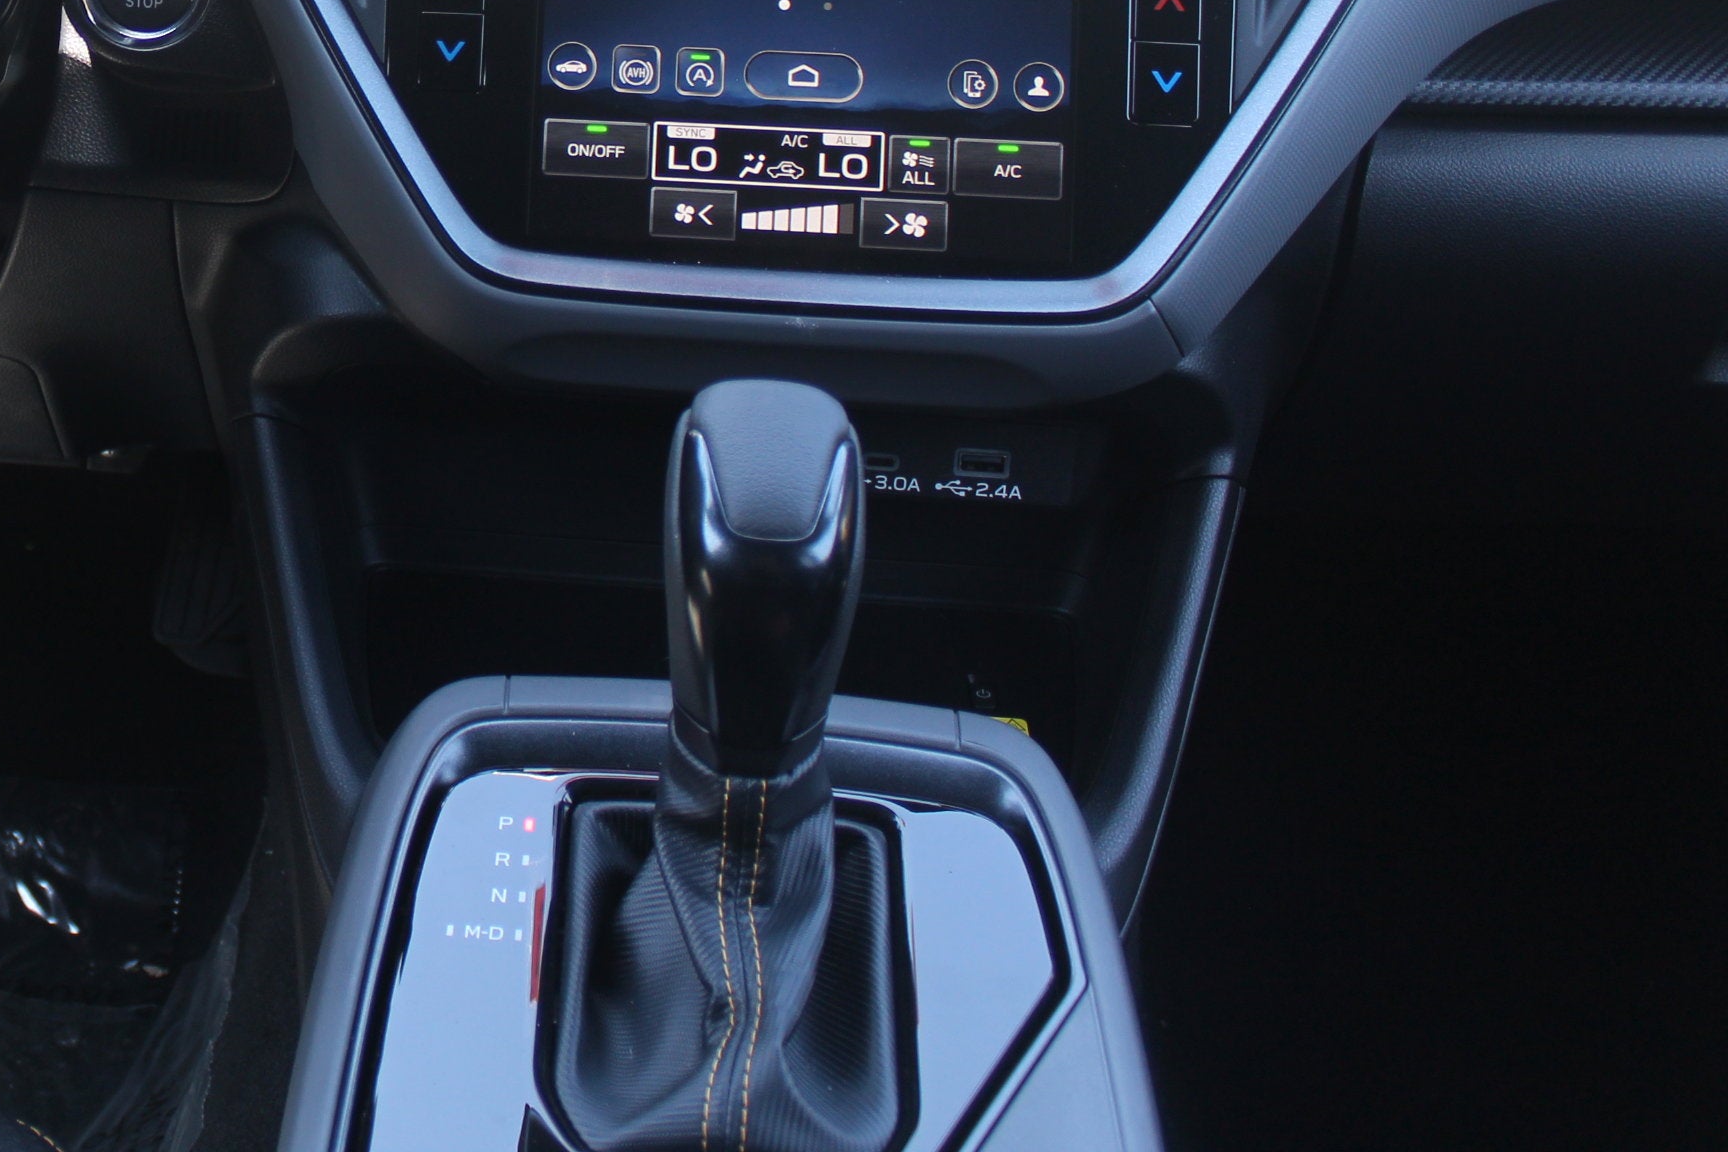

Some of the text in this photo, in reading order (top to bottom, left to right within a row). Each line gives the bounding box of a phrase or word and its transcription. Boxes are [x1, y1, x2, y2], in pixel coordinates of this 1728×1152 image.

[626, 66, 646, 79] AVH
[675, 127, 706, 137] SYNC
[836, 135, 858, 145] ALL
[781, 134, 809, 148] A/C
[567, 142, 625, 159] ON/OFF
[667, 144, 718, 172] LO
[817, 152, 870, 180] LO
[994, 163, 1022, 179] A/C
[902, 169, 935, 186] ALL
[874, 475, 921, 494] 3.0A
[975, 482, 1023, 500] 2.4A
[498, 816, 514, 831] P
[494, 852, 511, 867] R
[491, 887, 508, 903] N
